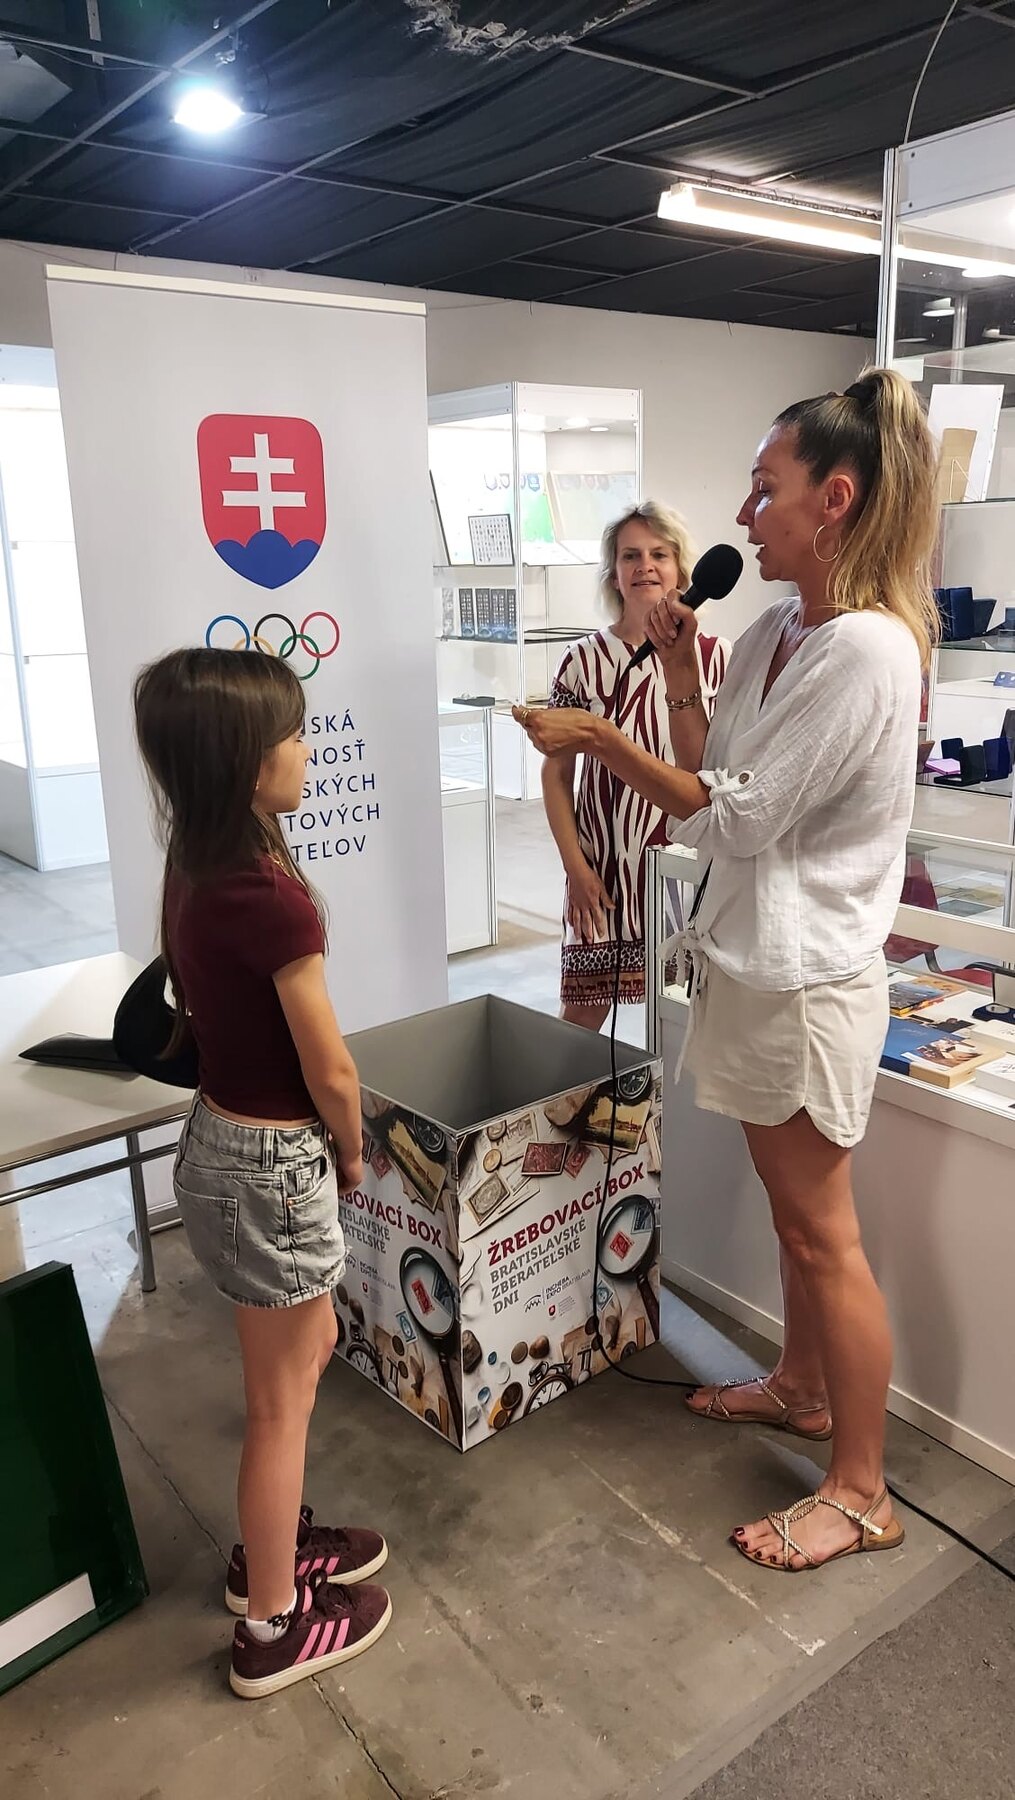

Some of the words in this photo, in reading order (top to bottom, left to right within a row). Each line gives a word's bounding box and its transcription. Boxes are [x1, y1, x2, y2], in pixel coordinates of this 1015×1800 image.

[302, 709, 355, 734] SKÁ
[305, 739, 366, 766] NOSŤ
[302, 773, 375, 799] SKÝCH
[284, 803, 380, 832] TOVÝCH
[291, 835, 366, 862] TEĽOV
[338, 1205, 391, 1241] TISLAVSKÉ
[487, 1181, 602, 1267] ŽREBOVACÍ
[606, 1162, 645, 1197] BOX
[341, 1221, 387, 1254] ATEĽSKÉ
[406, 1214, 442, 1249] BOX
[490, 1216, 586, 1284] BRATISLAVSKÉ
[491, 1235, 581, 1300] ZBERATEĽSKÉ
[545, 1276, 570, 1294] INCHEBA
[546, 1286, 562, 1300] EXPO
[493, 1289, 519, 1315] DNI
